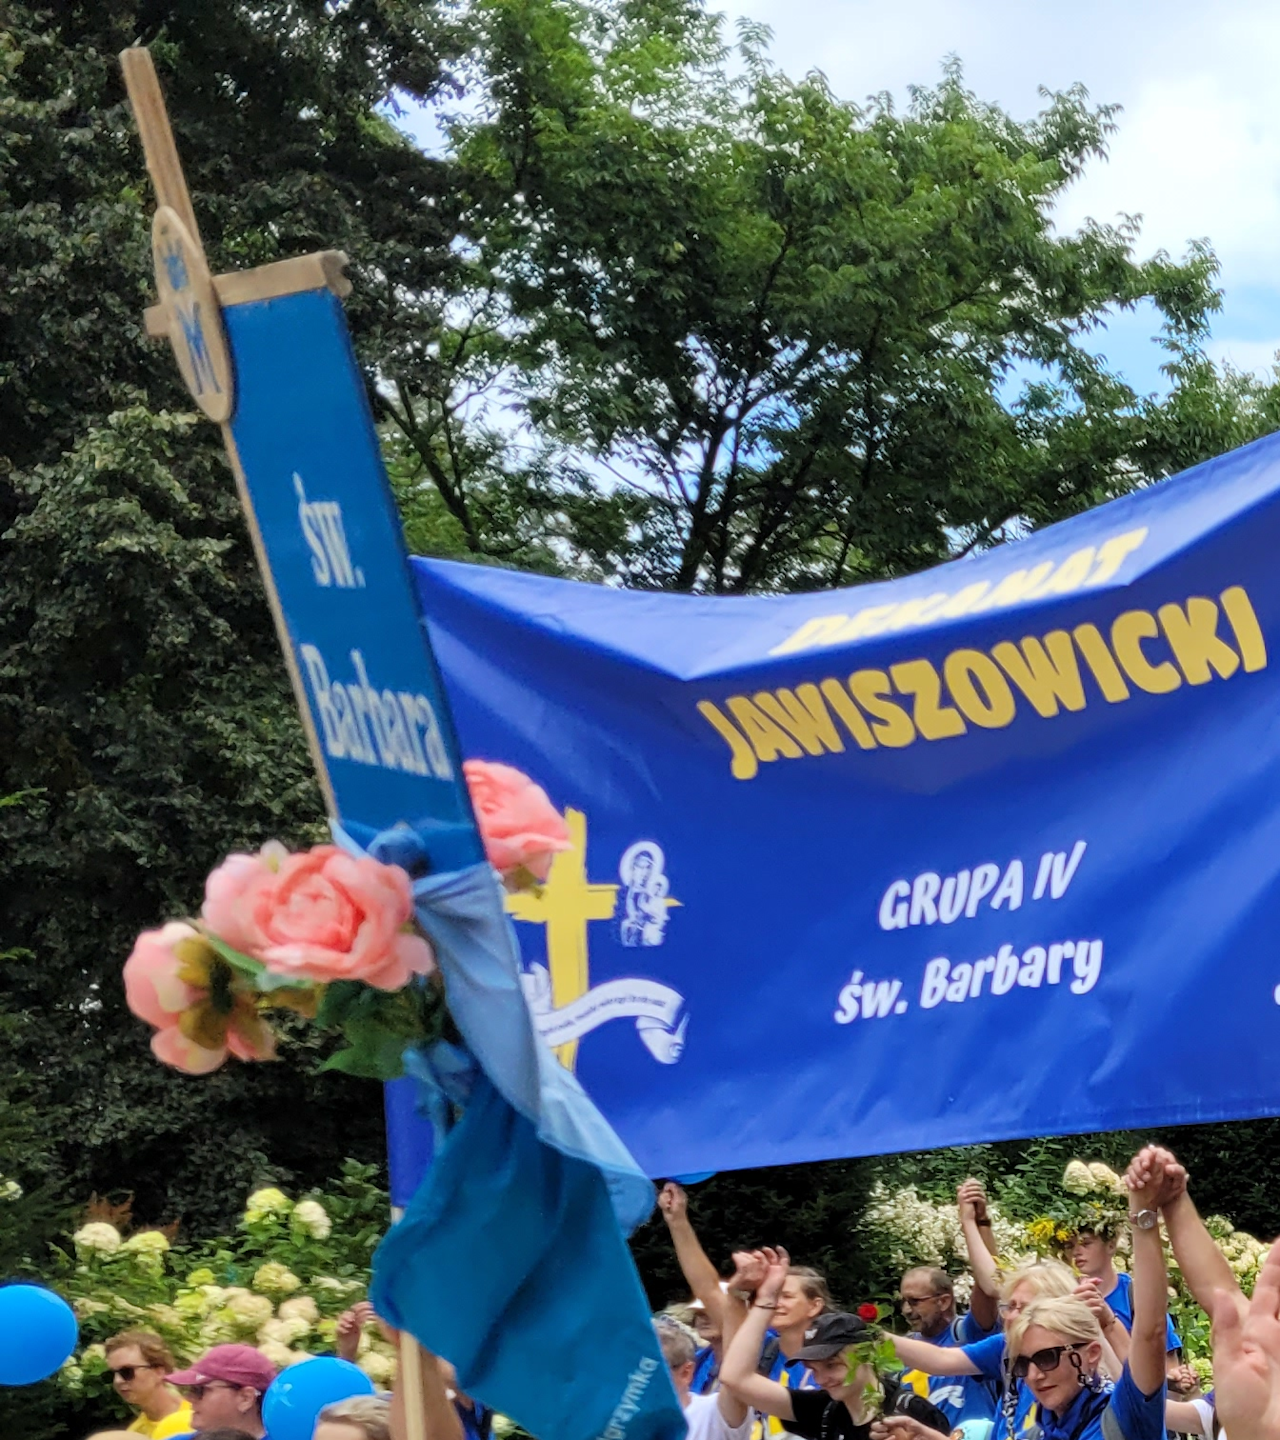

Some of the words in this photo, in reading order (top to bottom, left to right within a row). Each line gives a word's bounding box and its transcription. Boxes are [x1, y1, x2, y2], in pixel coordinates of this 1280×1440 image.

[293, 471, 366, 588] św.
[768, 526, 1150, 656] DEKANAT
[300, 642, 455, 782] Barbara
[696, 584, 1269, 782] JAWISZOWICKI
[878, 858, 1025, 931] GRUPA
[1031, 838, 1089, 900] IV
[833, 968, 910, 1025] św.
[919, 938, 1104, 1010] Barbary
